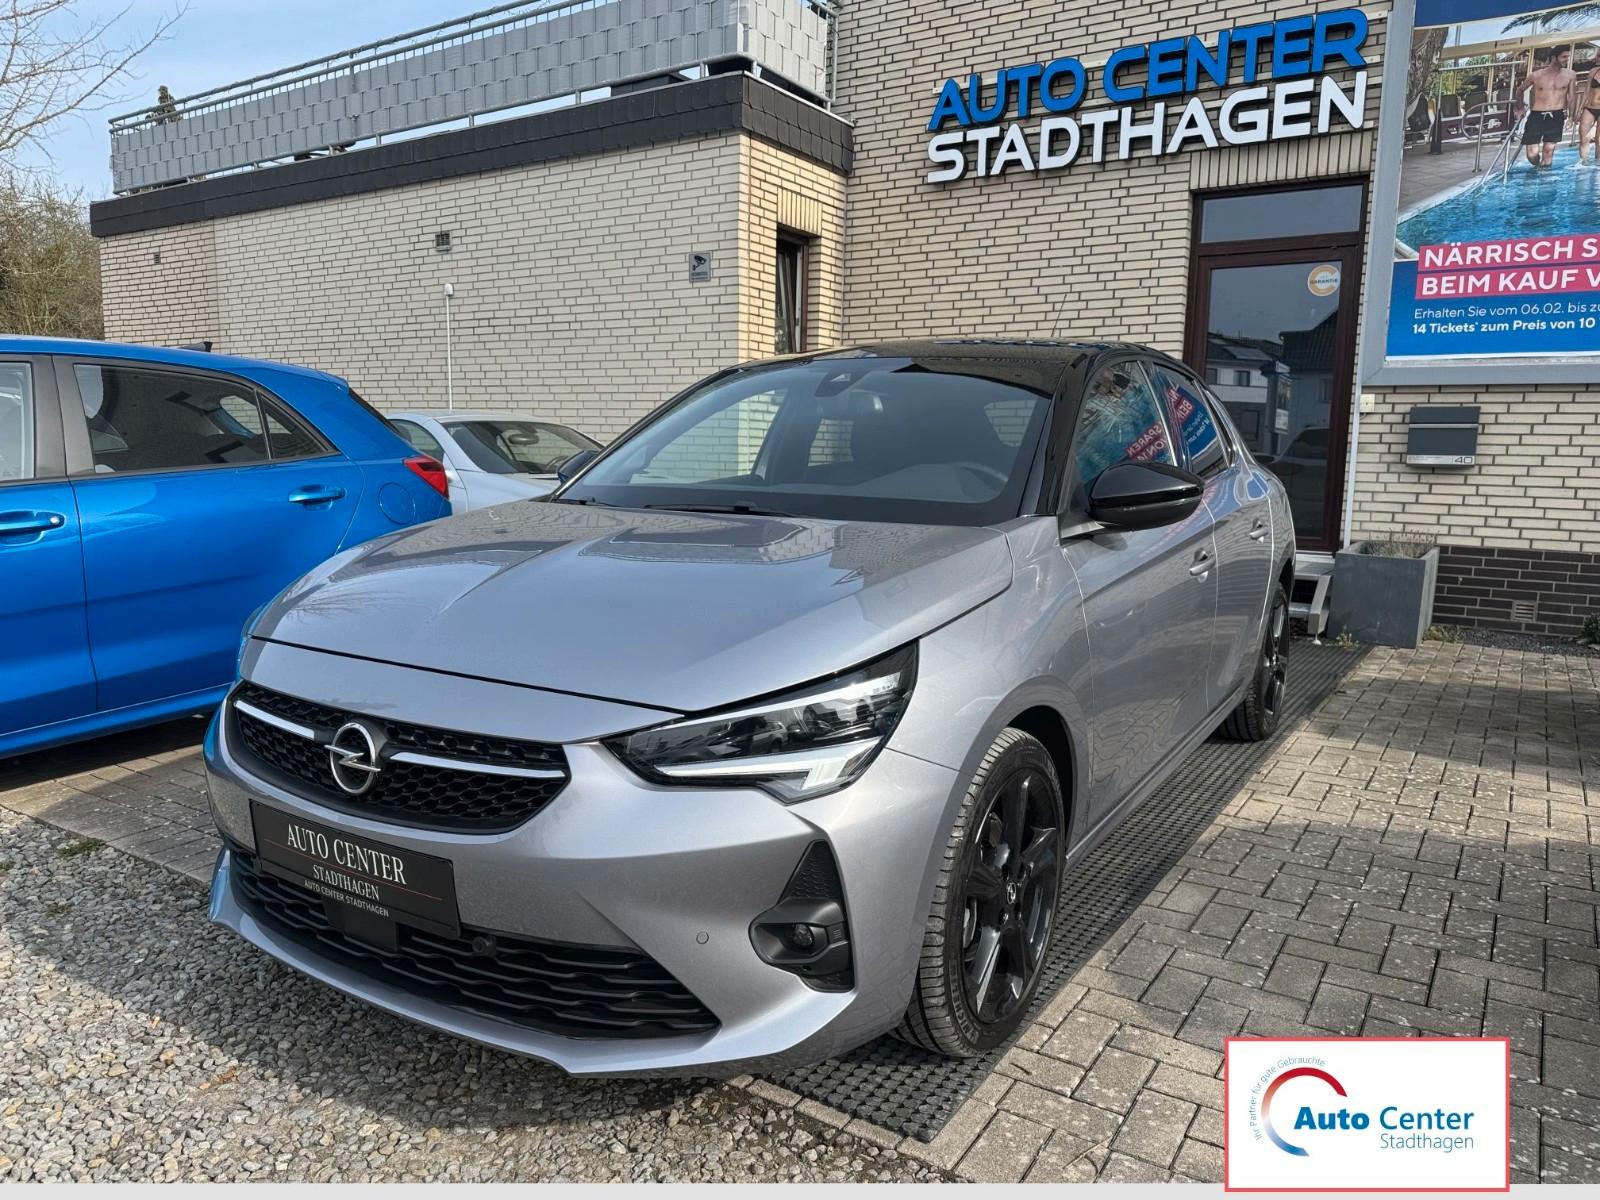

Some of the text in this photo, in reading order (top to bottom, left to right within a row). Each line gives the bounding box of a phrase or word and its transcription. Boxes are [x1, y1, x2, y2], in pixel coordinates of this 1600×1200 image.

[928, 9, 1369, 131] AUTO CENTER
[928, 71, 1368, 183] STADTHAGEN
[1424, 239, 1574, 268] NÄRRISCH
[1421, 273, 1491, 296] BEIM
[1498, 269, 1579, 292] KAUF
[1412, 323, 1427, 334] 14
[1480, 323, 1509, 332] zum
[1513, 319, 1547, 331] Preis
[1549, 320, 1575, 330] von
[1579, 316, 1596, 329] 10
[1414, 305, 1465, 319] Erhalten
[1467, 306, 1487, 317] Sie
[1489, 308, 1518, 316] vom
[1520, 302, 1564, 315] 06.02.
[1568, 301, 1587, 313] bis
[1454, 456, 1473, 464] 40
[287, 823, 407, 885] AUTO CENTER
[304, 879, 389, 917] AUTO CENTER STADTHAGEN
[313, 864, 380, 901] STADTHAGEN
